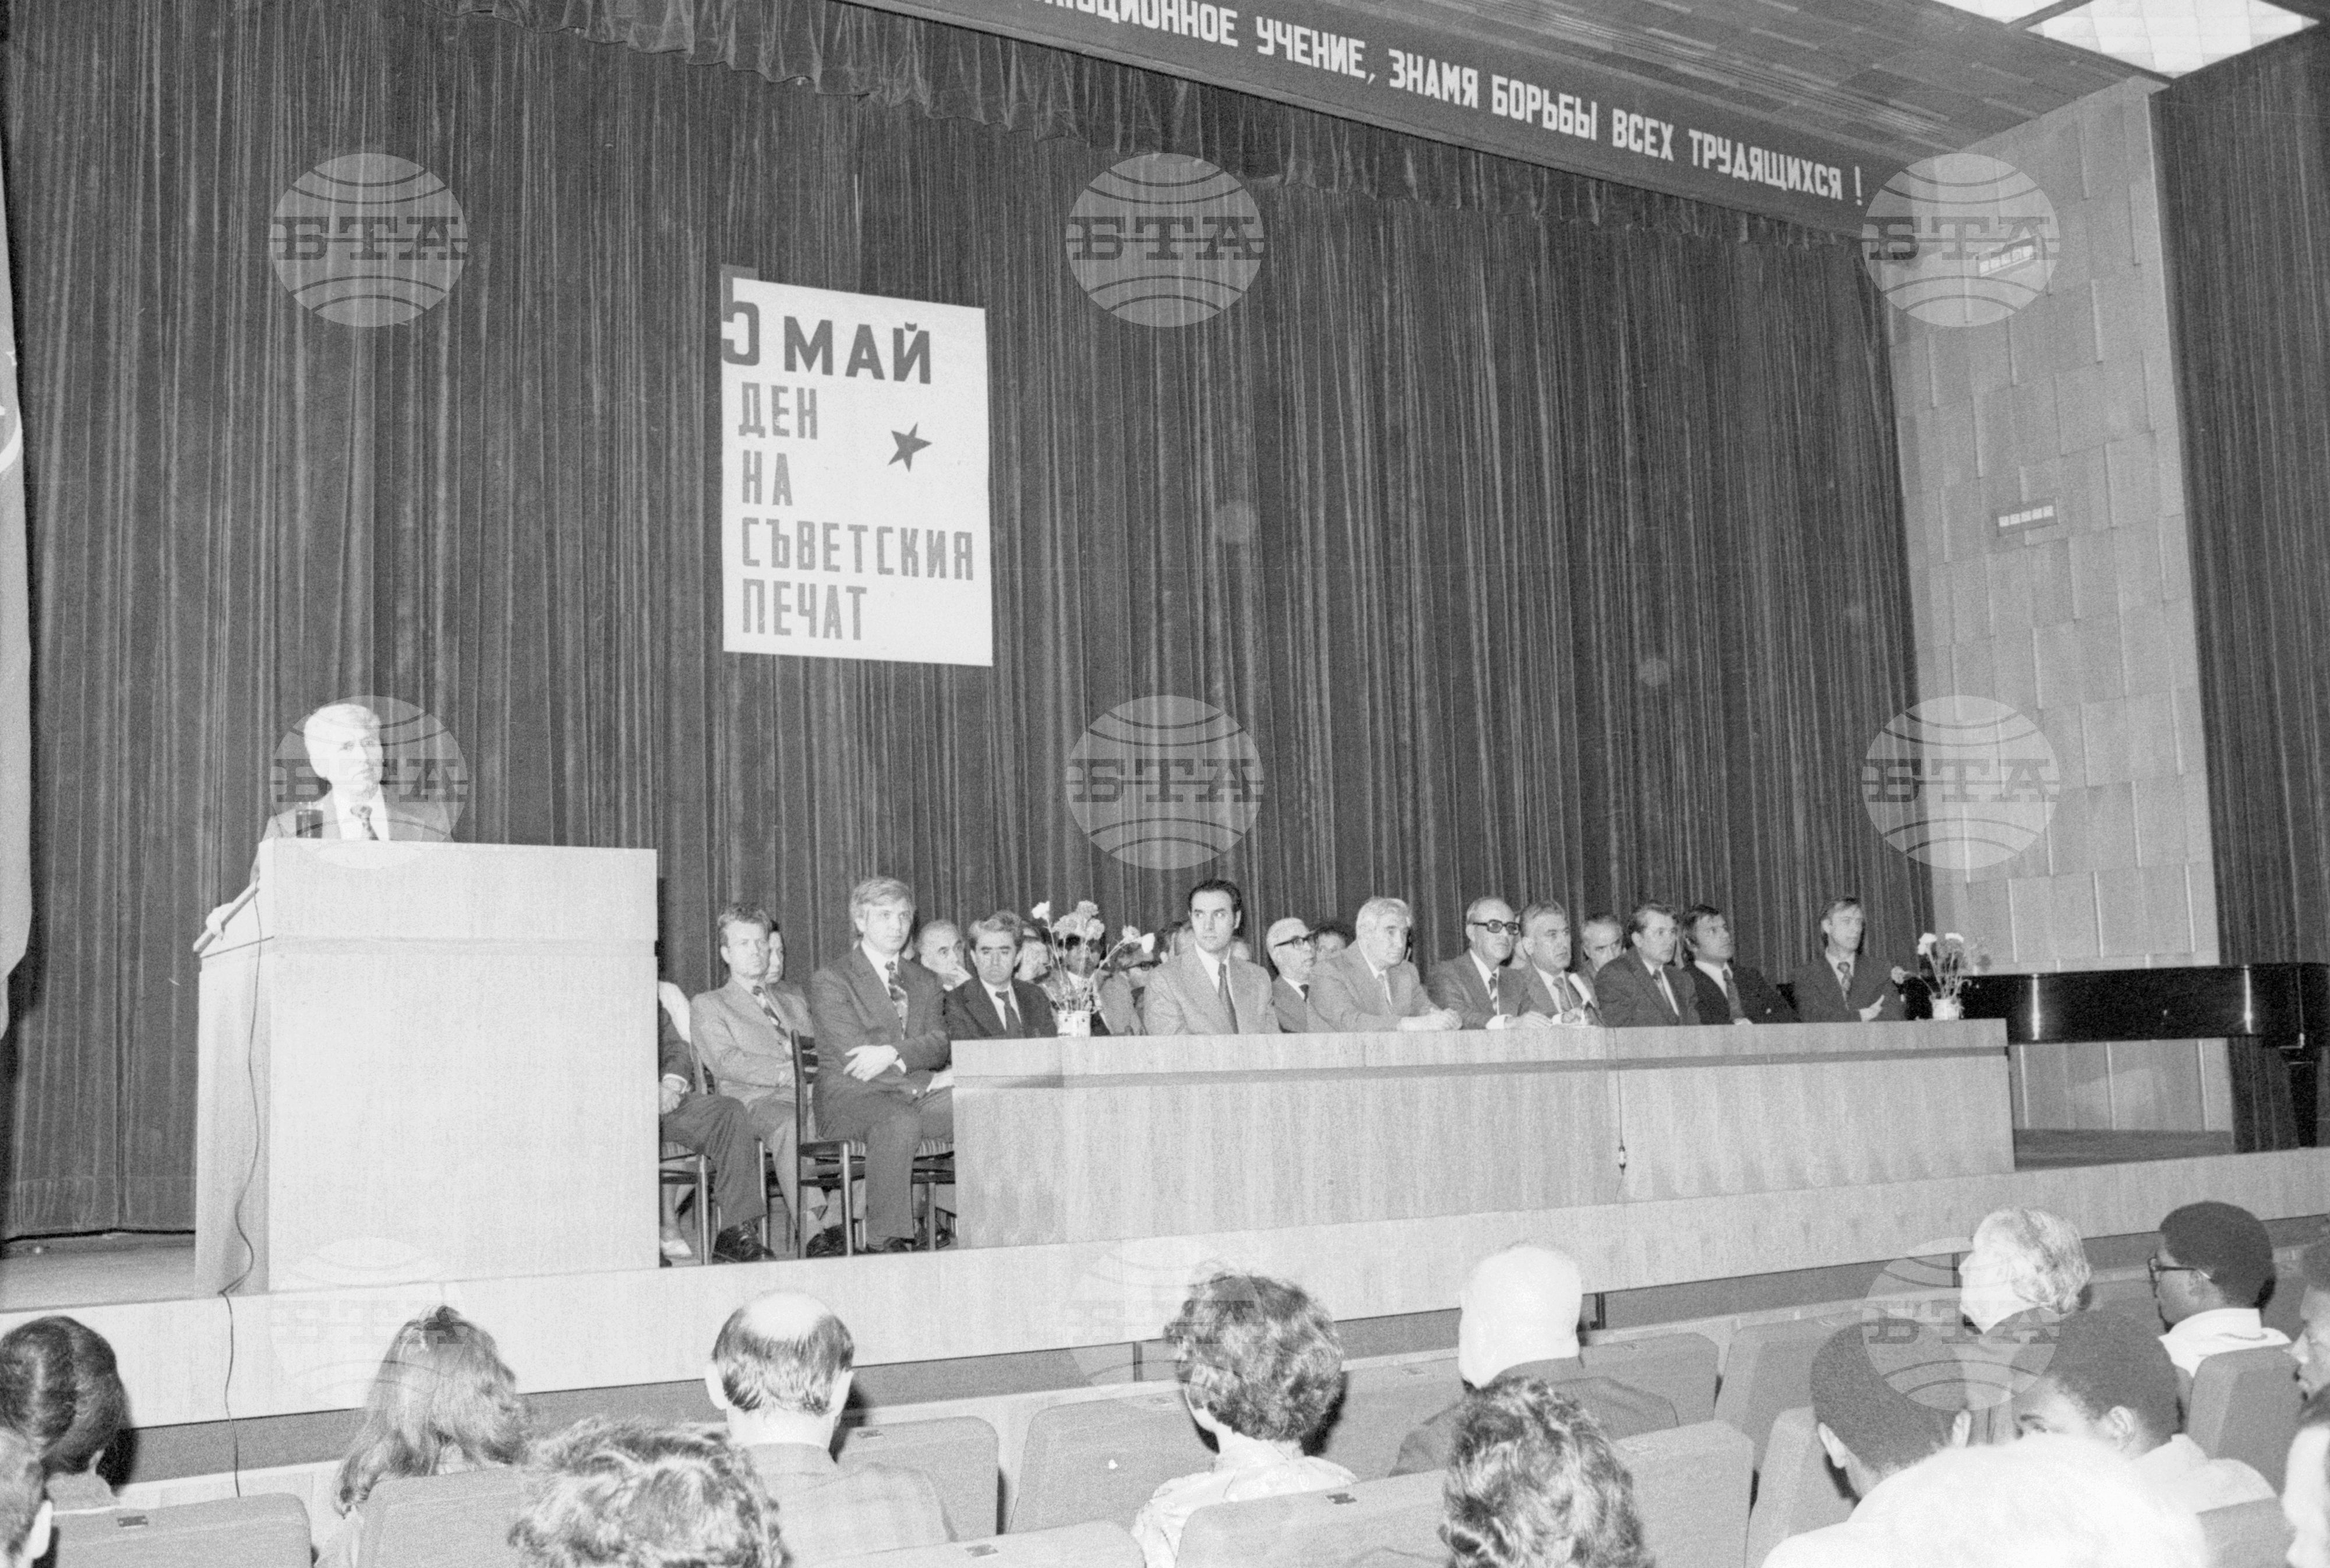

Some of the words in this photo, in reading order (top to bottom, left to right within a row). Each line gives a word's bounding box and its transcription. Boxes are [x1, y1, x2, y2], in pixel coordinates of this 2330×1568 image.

[1256, 16, 1376, 84] УЧЕНИЕ,
[1388, 48, 1478, 108] ЗНАМЯ
[1492, 75, 1597, 140] БОРЬБЫ
[1612, 108, 1674, 161] ВСЕХ
[1689, 129, 1842, 199] ТРУДЯЩИХСЯ
[721, 264, 760, 366] 5
[783, 315, 931, 385] МАЙ
[738, 382, 818, 446] ДЕН
[742, 449, 793, 506] НА
[742, 516, 974, 581] СЪВЕТСКИЯ
[742, 578, 867, 641] ПЕЧАТ
